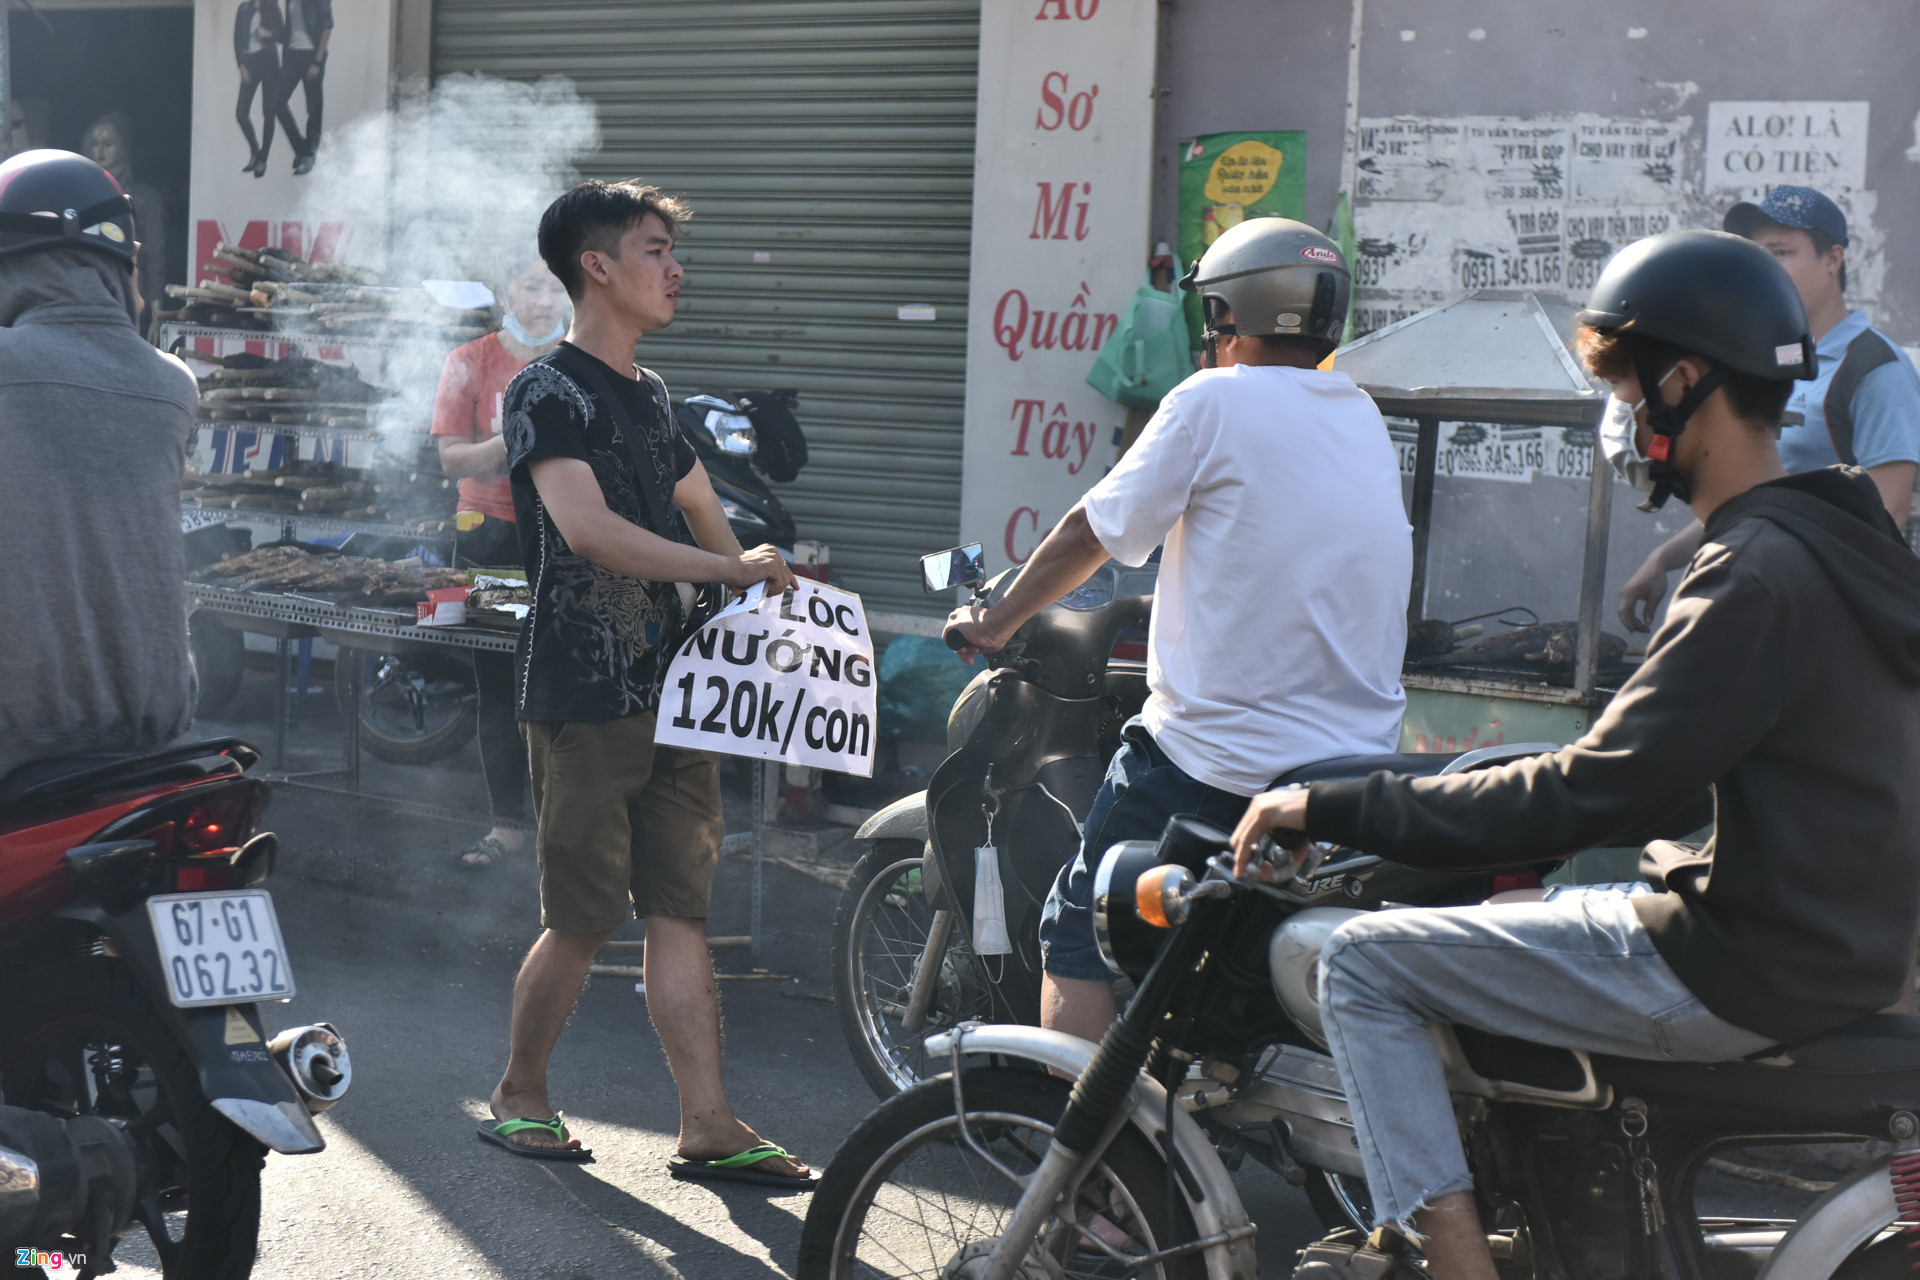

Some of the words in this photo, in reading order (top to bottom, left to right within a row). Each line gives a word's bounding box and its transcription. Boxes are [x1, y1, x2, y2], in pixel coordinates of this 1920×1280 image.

[1036, 72, 1099, 131] Sơ
[1725, 115, 1794, 138] ALO!
[1804, 107, 1841, 138] LÀ
[1029, 182, 1092, 241] Mi
[1461, 255, 1561, 290] 0931.345.166
[1010, 399, 1096, 475] Tây
[779, 586, 859, 637] LÓC
[682, 627, 872, 688] NƯỚNG
[672, 671, 871, 757] 120k/con
[172, 947, 286, 999] 062.32
